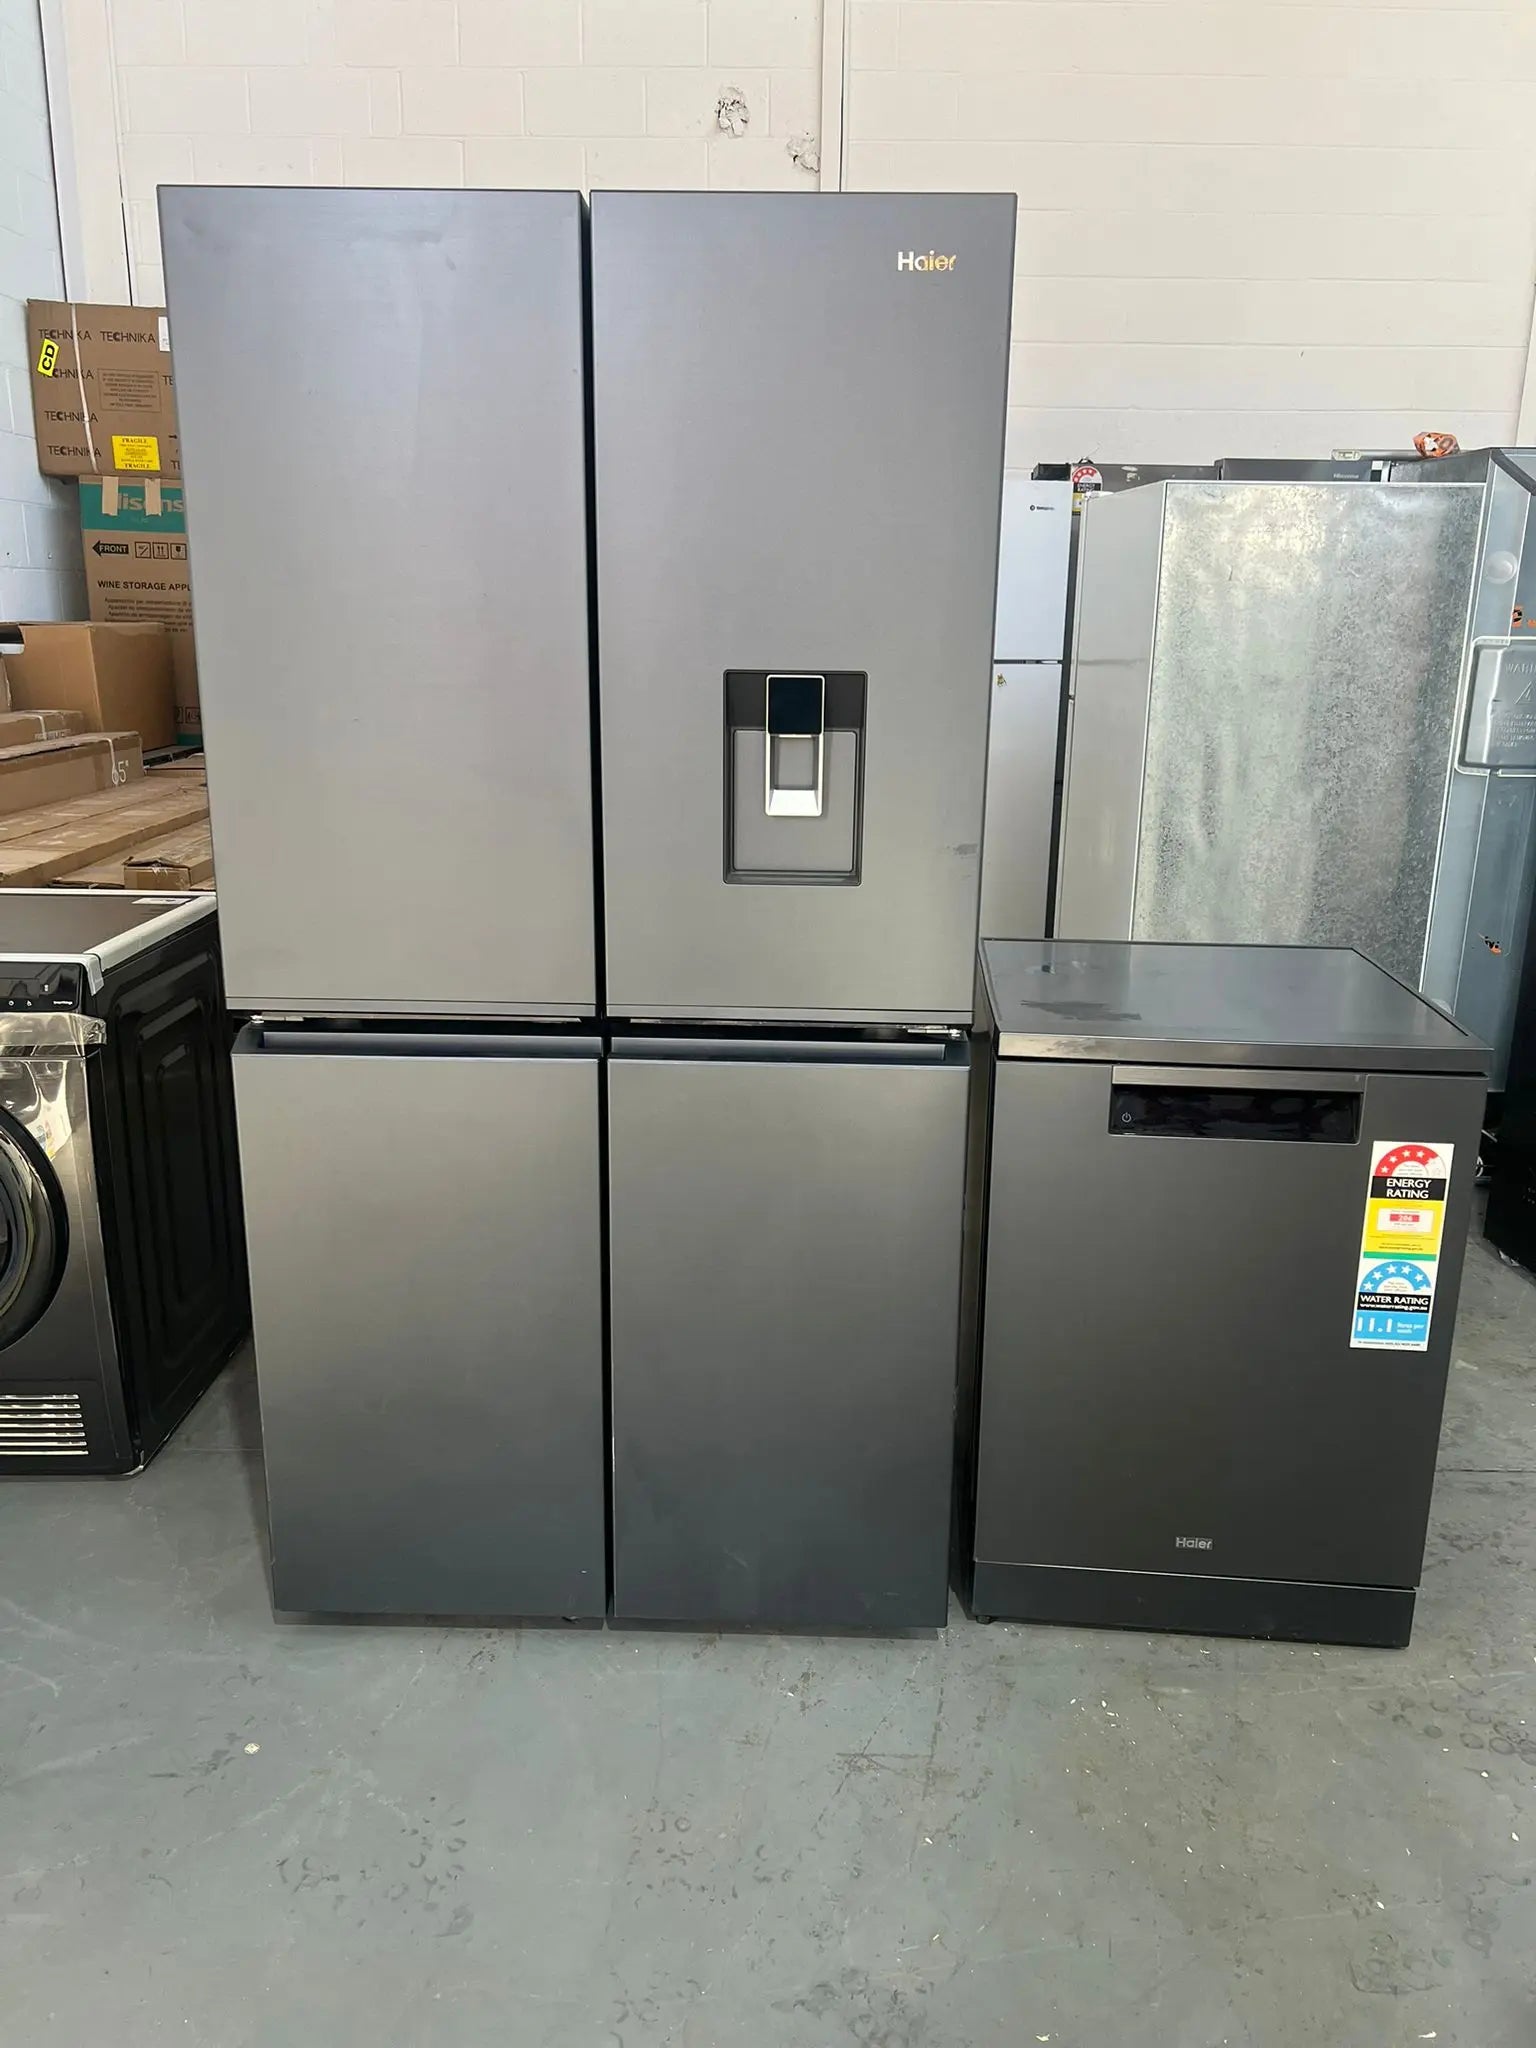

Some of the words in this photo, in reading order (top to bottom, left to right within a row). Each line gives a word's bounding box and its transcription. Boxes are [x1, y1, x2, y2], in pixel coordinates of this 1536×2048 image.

[897, 250, 957, 271] Haier
[38, 328, 92, 341] TECHNKA
[99, 330, 156, 344] TECHNIKA
[41, 344, 55, 371] CD
[99, 545, 128, 554] FRONT
[97, 580, 121, 590] WINE
[122, 582, 167, 591] STORAGE
[1386, 1178, 1432, 1189] ENERGY
[1386, 1188, 1430, 1199] RATING
[1360, 1294, 1392, 1304] WATER
[1393, 1296, 1429, 1306] RATING
[1357, 1316, 1393, 1333] 11.1
[1175, 1536, 1213, 1550] Haier
